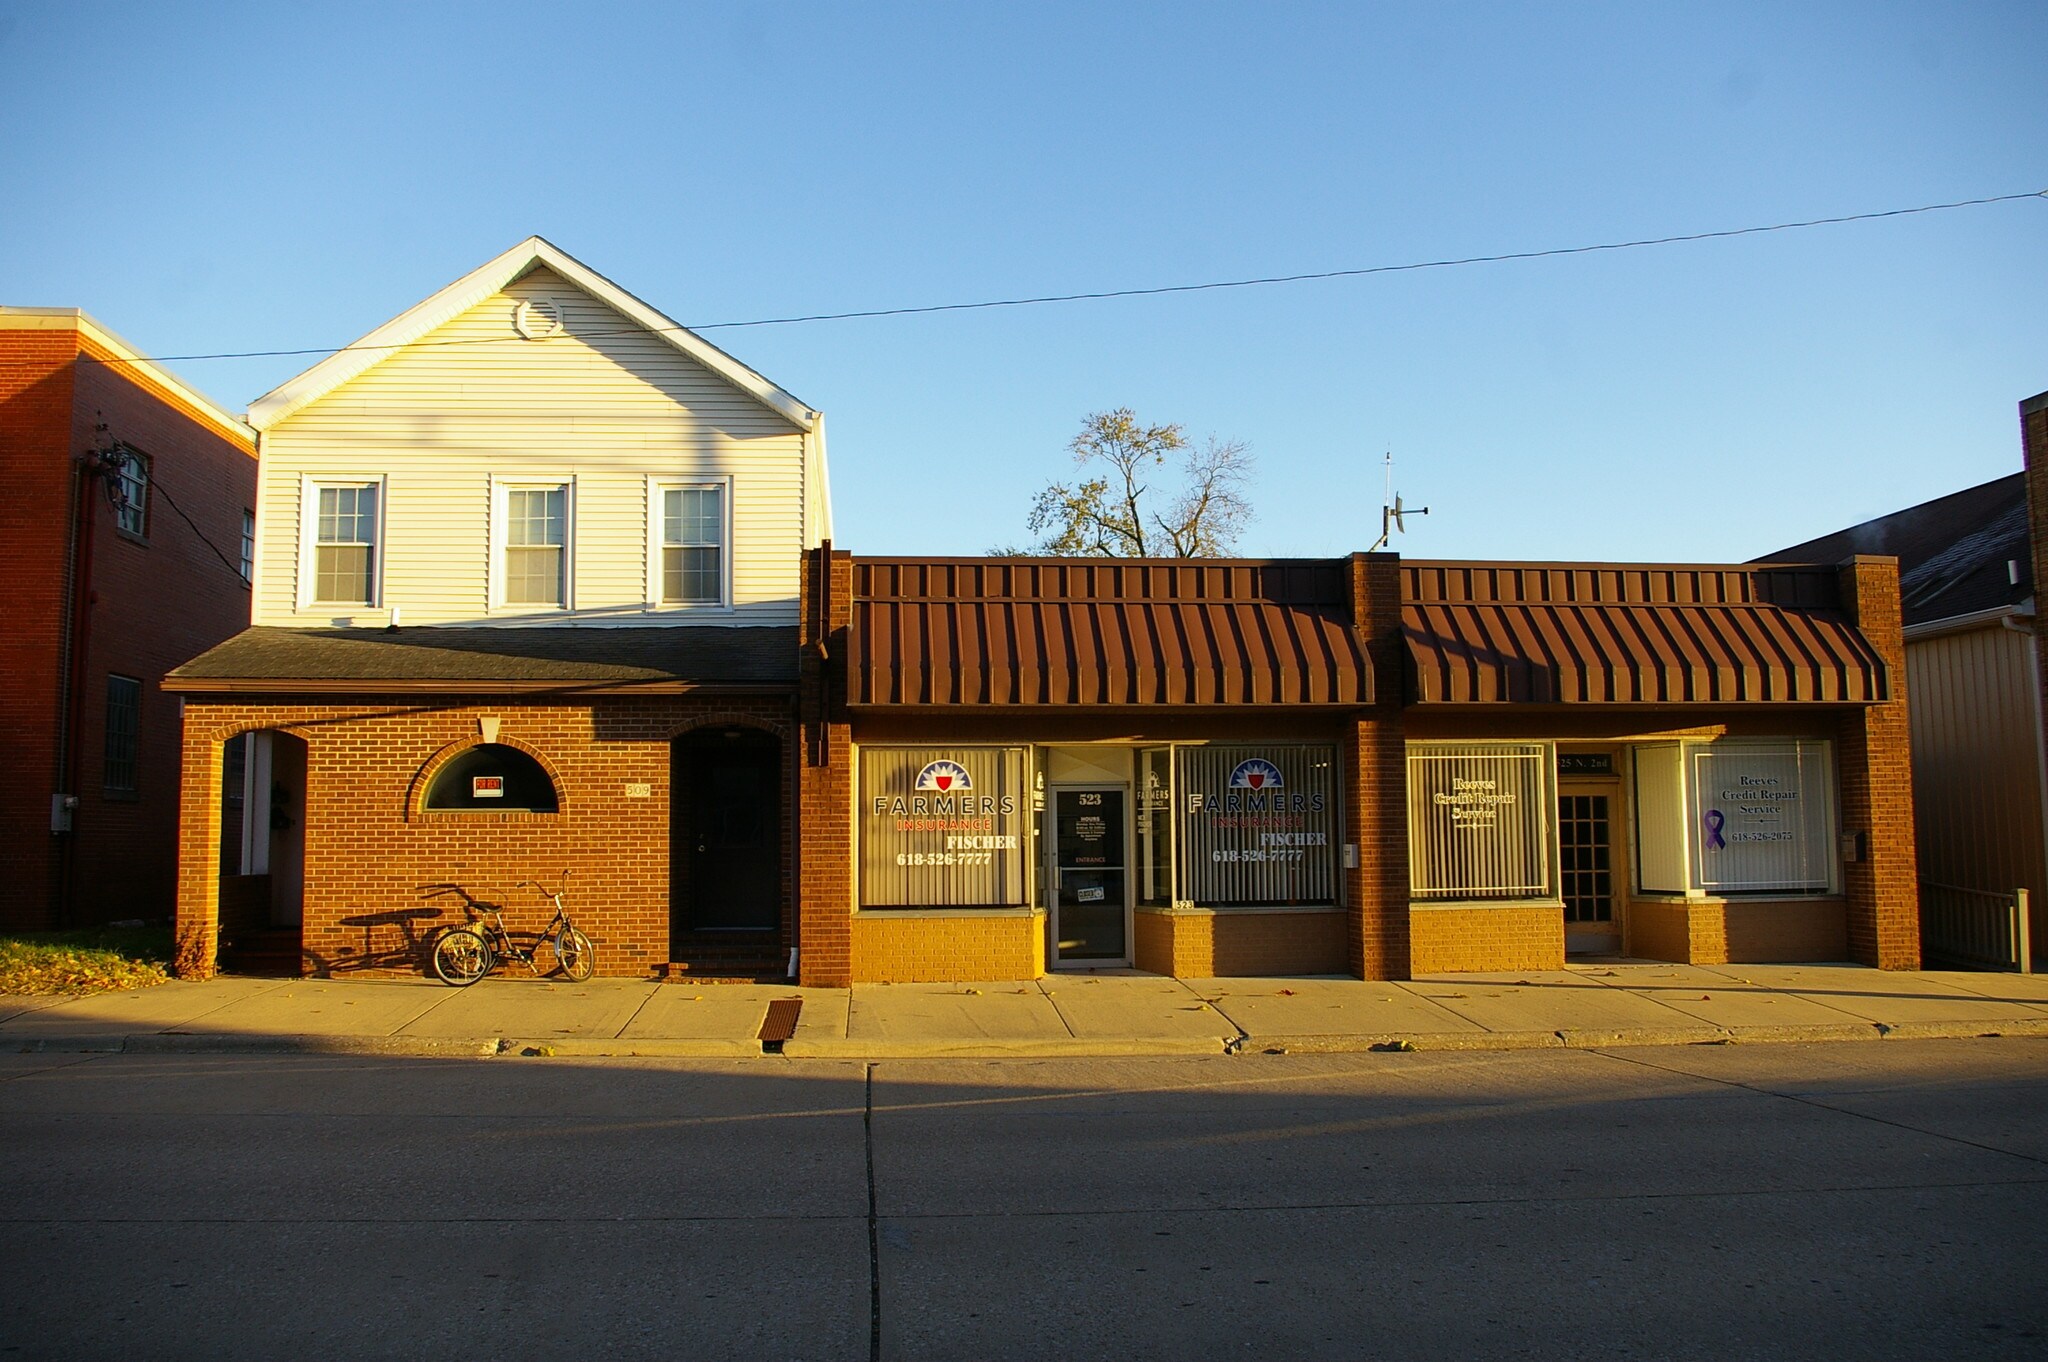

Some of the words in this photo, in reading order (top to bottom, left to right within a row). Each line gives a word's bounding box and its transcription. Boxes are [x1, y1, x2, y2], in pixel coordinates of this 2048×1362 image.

[1591, 758, 1608, 768] 2nd
[1453, 778, 1496, 790] Reeves
[1740, 776, 1779, 786] Reeves
[627, 785, 650, 795] 509
[1722, 790, 1757, 801] Credit
[1760, 789, 1797, 801] Repair
[1078, 793, 1102, 806] 523
[1189, 794, 1325, 814] FARMERS
[1434, 792, 1474, 805] Credit
[1475, 792, 1516, 806] Repair
[874, 796, 1015, 815] FARMERS
[1740, 804, 1781, 815] Service
[1451, 808, 1497, 819] Service
[896, 819, 992, 831] INSURANCE
[1212, 816, 1304, 828] INSURANCE
[947, 835, 1017, 850] FISCHER
[1260, 833, 1327, 846] FISCHER
[1732, 832, 1793, 841] 618-526-2075
[896, 853, 992, 866] 618-526-7777
[1212, 850, 1303, 863] 618-526-7777
[1176, 901, 1193, 909] 523
